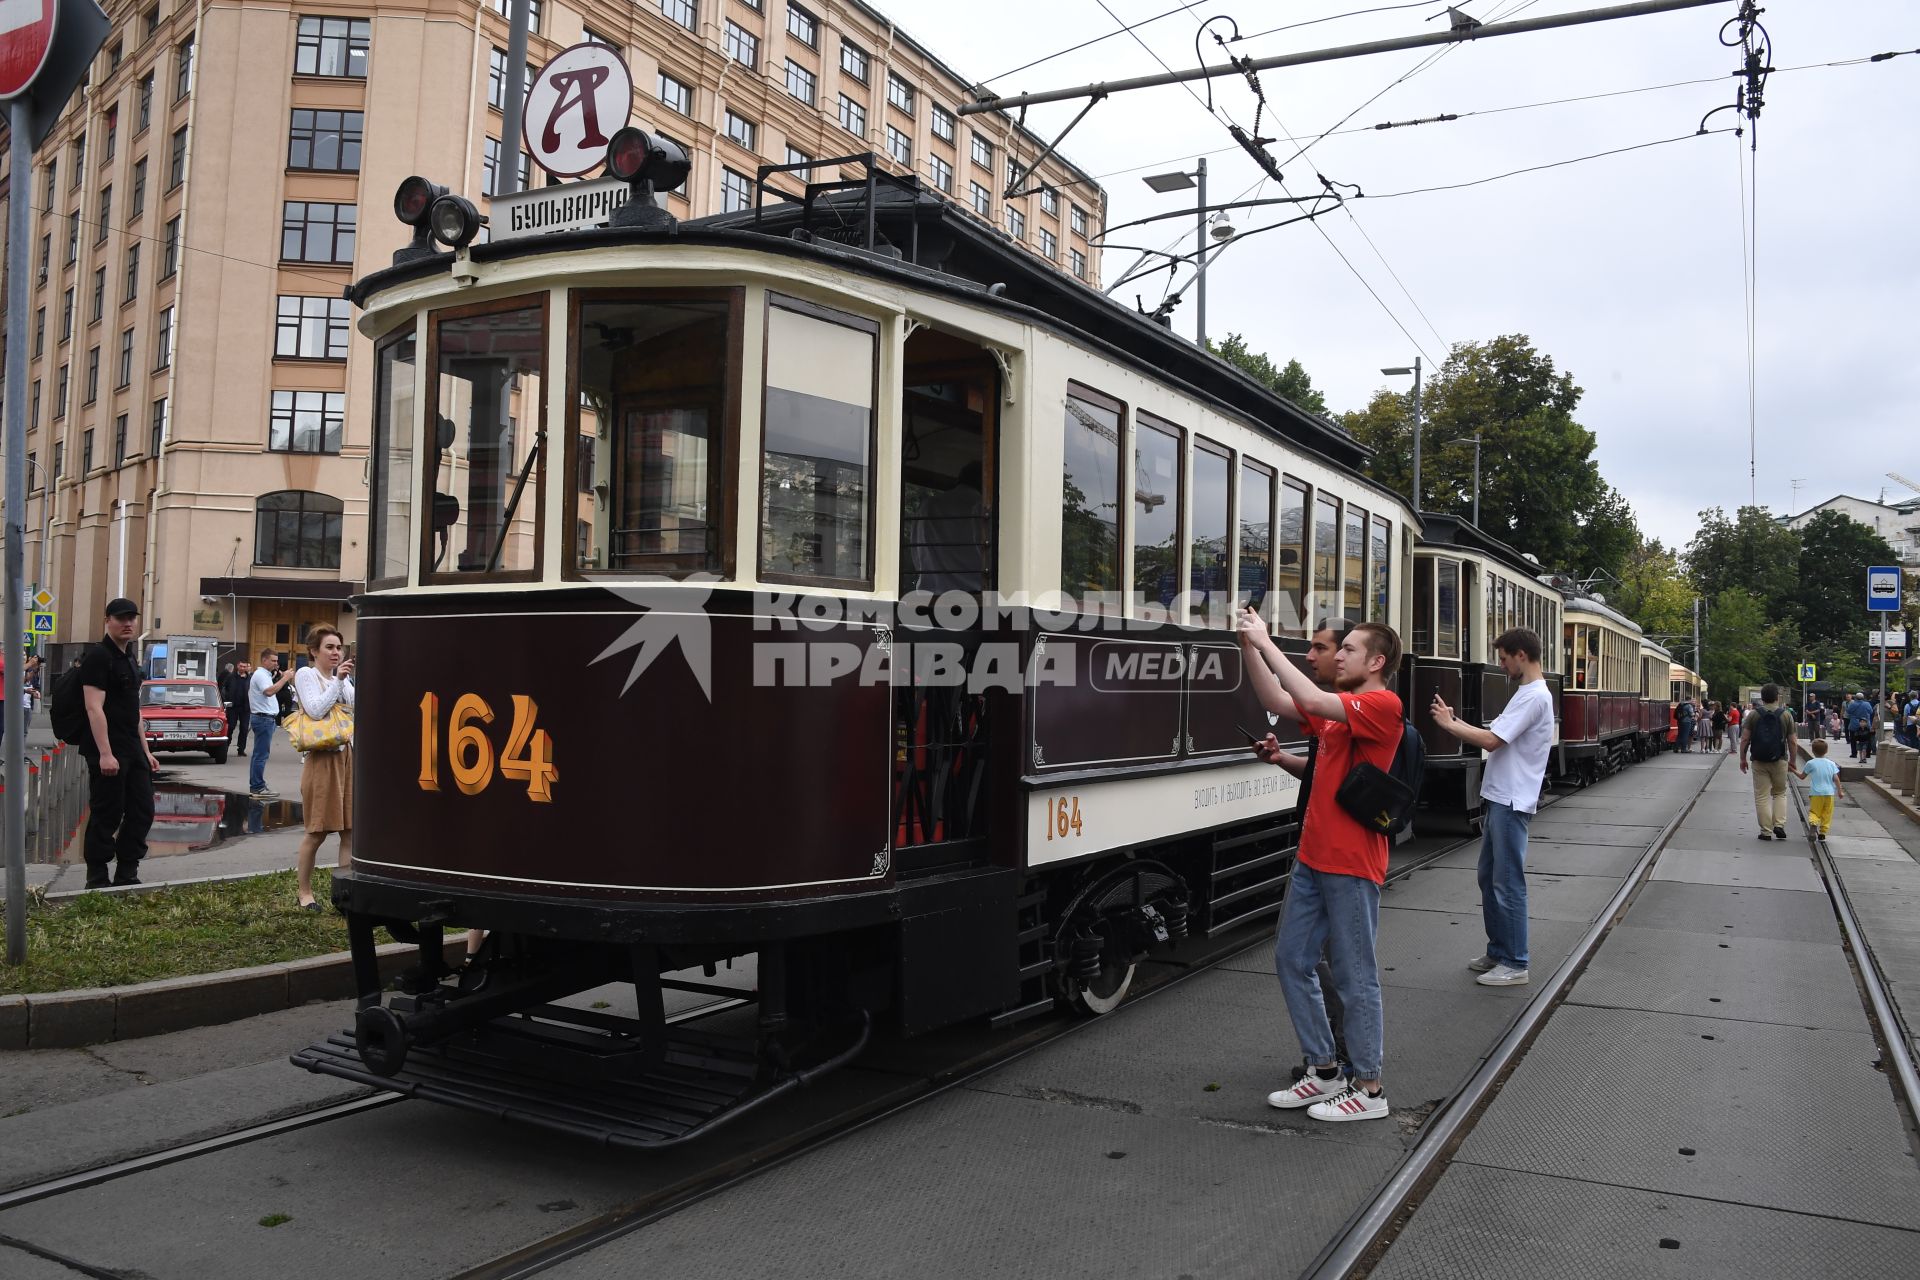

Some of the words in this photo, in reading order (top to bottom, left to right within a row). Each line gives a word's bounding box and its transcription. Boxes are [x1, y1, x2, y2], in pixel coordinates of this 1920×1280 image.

[511, 187, 629, 232] БУЛЬВАРНА
[418, 691, 560, 803] 164
[1194, 786, 1218, 810] ВХОДИТЬ
[1220, 784, 1225, 804] И
[1226, 780, 1252, 802] ВЫХОДИТЬ
[1254, 778, 1261, 797] ВО
[1262, 775, 1278, 795] ВРЕМЯ
[1047, 796, 1083, 841] 164
